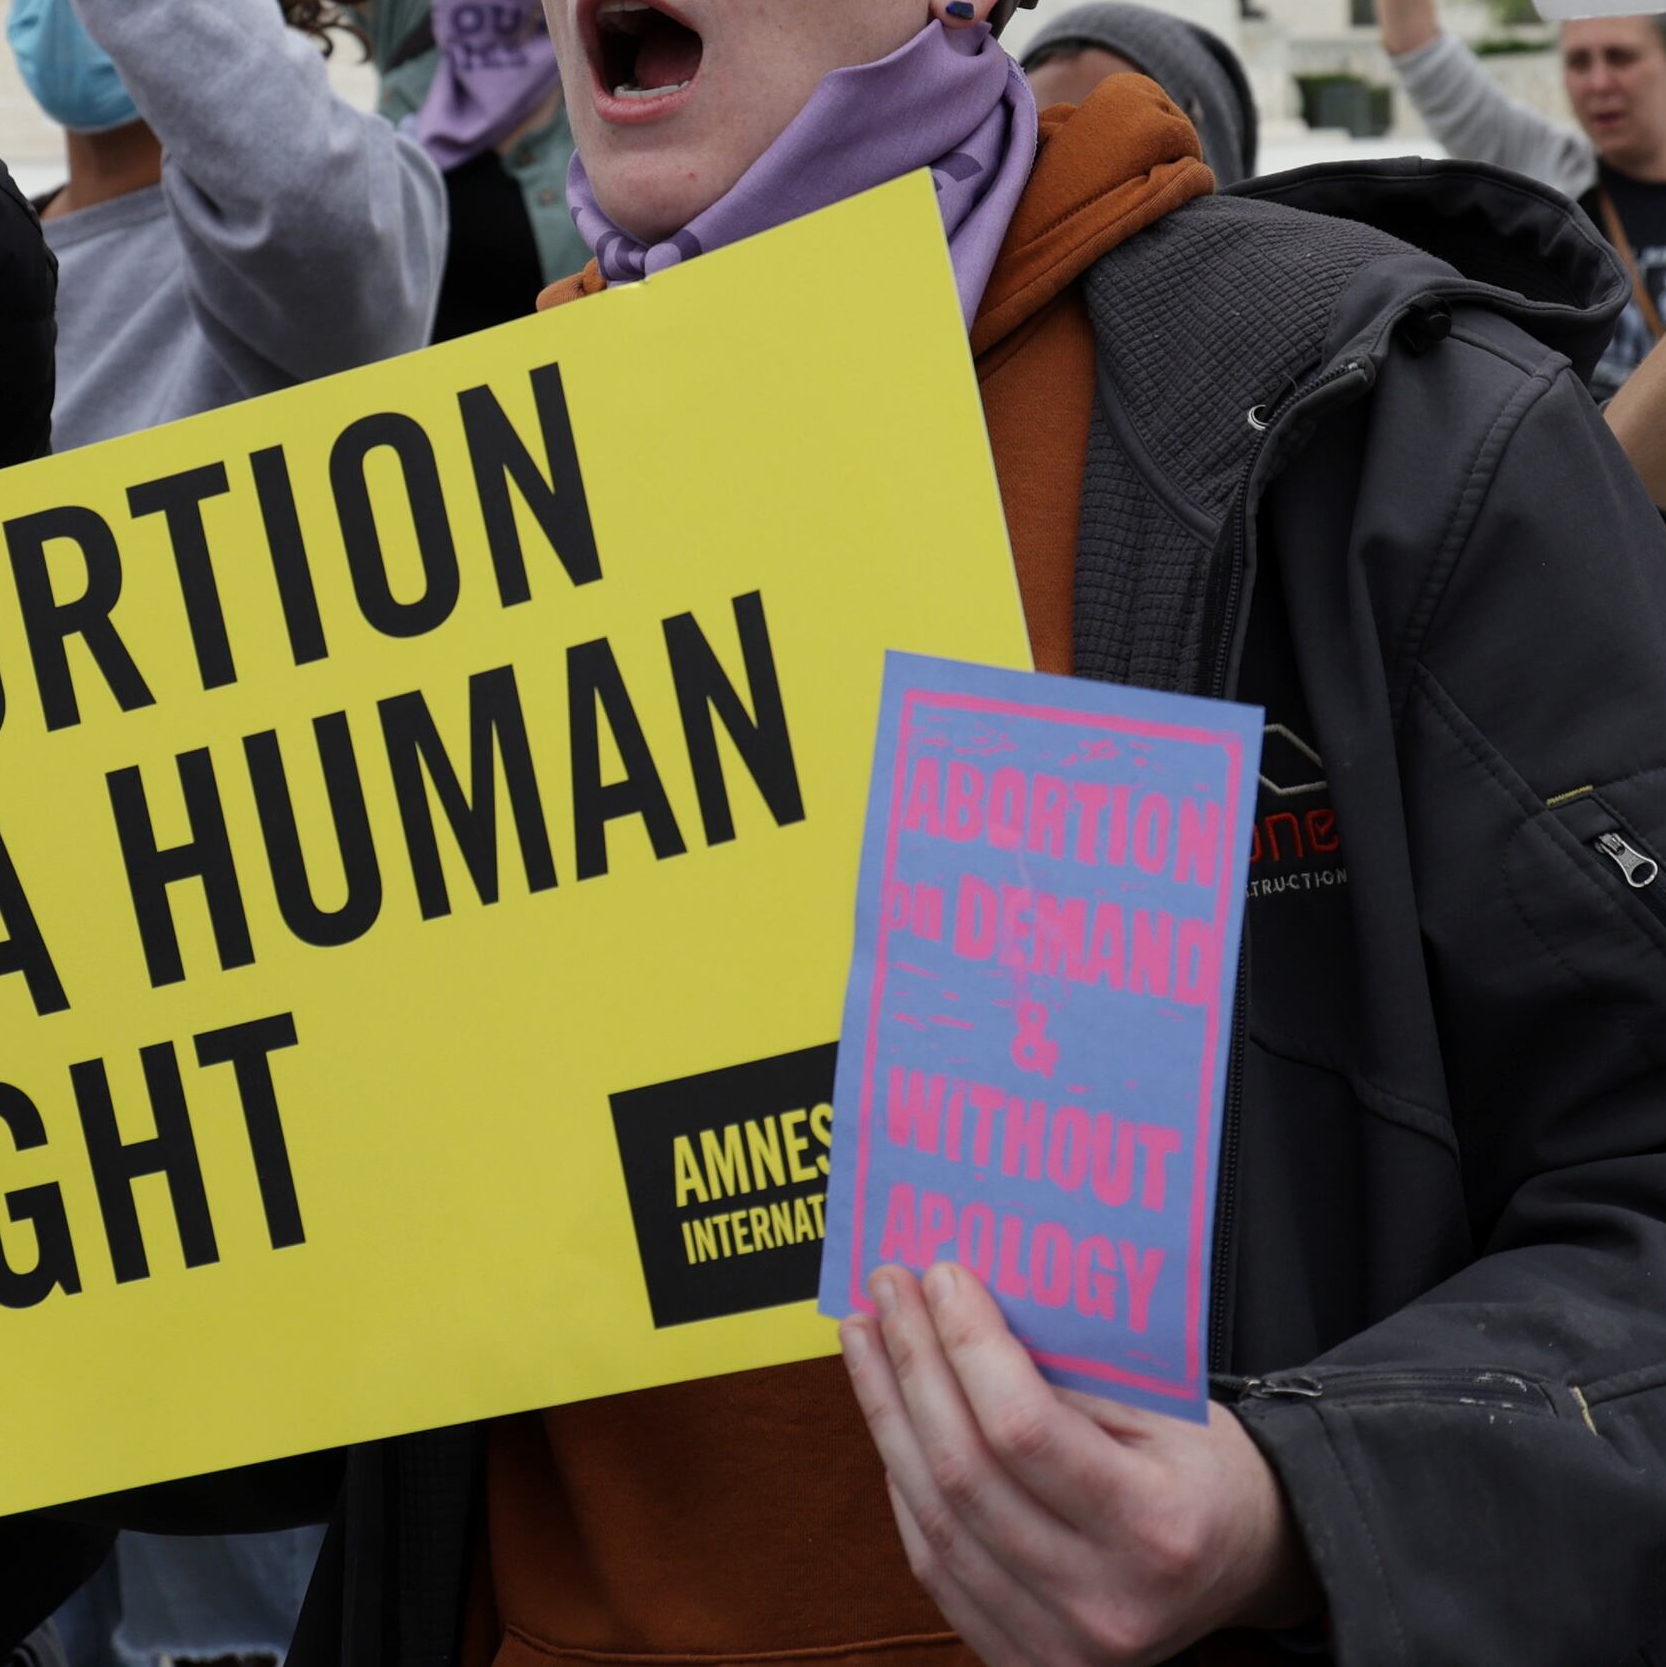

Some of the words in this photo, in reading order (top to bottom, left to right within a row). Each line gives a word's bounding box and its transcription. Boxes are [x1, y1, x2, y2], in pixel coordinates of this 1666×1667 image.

[106, 588, 807, 990] HUMAN
[901, 755, 1221, 888] ABORTION
[952, 873, 1218, 1006] DEMAND
[1247, 868, 1348, 898] TRUCTION
[1010, 1001, 1059, 1078] &
[673, 1102, 833, 1208] AMNES
[885, 1065, 1181, 1211] WITHOUT
[681, 1191, 829, 1266] INTERNAT
[877, 1183, 1166, 1334] APOLOGY
